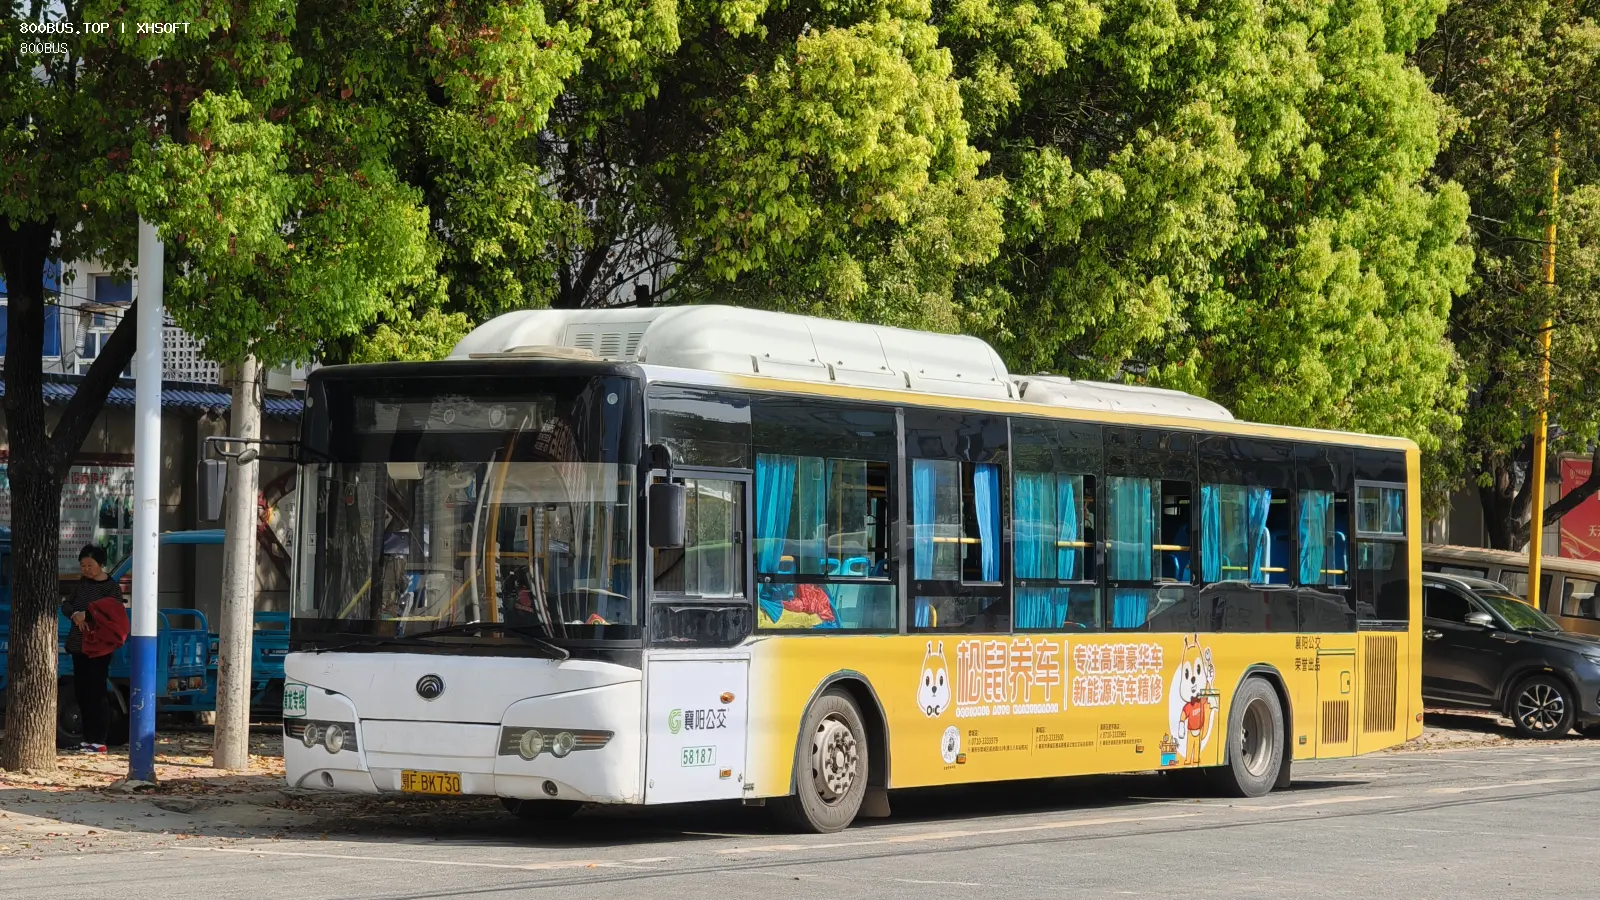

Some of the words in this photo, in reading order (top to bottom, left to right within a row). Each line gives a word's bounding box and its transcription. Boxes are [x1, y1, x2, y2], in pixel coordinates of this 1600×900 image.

[1295, 635, 1321, 650] 襄阳公交
[956, 637, 1060, 705] 松鼠养车
[1073, 643, 1163, 675] 专注高端豪华车
[1072, 674, 1163, 706] 新能源汽车精修
[684, 708, 727, 731] 襄阳公交
[683, 748, 713, 765] 58187
